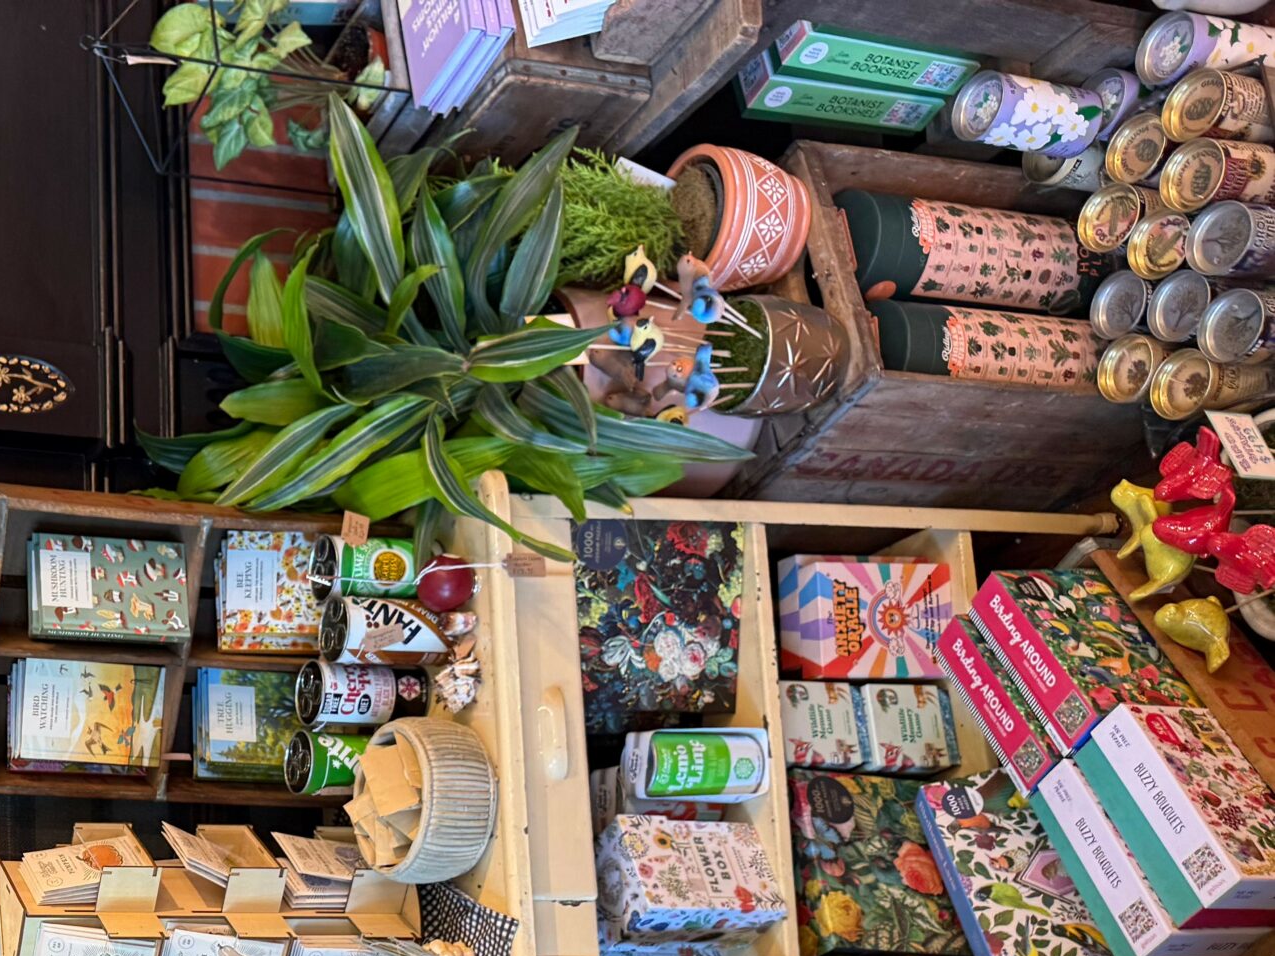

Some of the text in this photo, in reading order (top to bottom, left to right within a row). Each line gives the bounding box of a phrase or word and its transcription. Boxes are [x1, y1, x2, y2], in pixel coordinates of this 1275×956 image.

[849, 62, 918, 80] BOOKSHELF
[864, 54, 921, 68] BOTANIST
[815, 103, 881, 118] BOOKSHELF
[829, 96, 885, 110] BOTANIST
[1176, 160, 1191, 188] GIANT
[1217, 160, 1236, 200] GROW
[1253, 212, 1267, 248] GROW
[941, 326, 953, 362] Ridley's
[951, 326, 959, 362] JIGSAW
[956, 323, 965, 367] PUZZLES
[583, 531, 593, 558] 1000
[49, 554, 59, 602] MUSHROOM
[59, 560, 67, 598] HUNTING
[235, 572, 243, 588] BEE
[245, 562, 253, 598] KEEPING
[354, 552, 365, 578] LIME
[409, 603, 439, 622] DRAFT
[833, 578, 850, 656] ANXIETY
[845, 586, 866, 652] ORACLE
[989, 594, 1021, 646] Birding
[1019, 639, 1057, 688] AROUND
[951, 638, 1015, 732] Birding AROUND
[39, 683, 49, 730] WATCHING
[217, 702, 225, 724] TREE
[224, 692, 233, 734] HUGGING
[321, 694, 332, 714] SUGAR
[331, 696, 340, 713] FREE
[359, 698, 369, 712] DIET
[809, 704, 819, 739] Wildlife
[825, 709, 833, 734] Game
[817, 704, 827, 740] Memory
[899, 708, 909, 742] Wildlife
[906, 708, 917, 743] Memory
[914, 712, 923, 738] Game
[317, 736, 360, 775] rite
[812, 790, 825, 813] 1000
[947, 794, 961, 816] 1000
[1133, 762, 1185, 834] BUZZY BOUQUETS
[58, 853, 75, 874] PUMPKIN
[693, 836, 722, 894] FLOWER
[713, 850, 731, 880] BOX
[1075, 817, 1122, 888] BUZZY BOUQUETS
